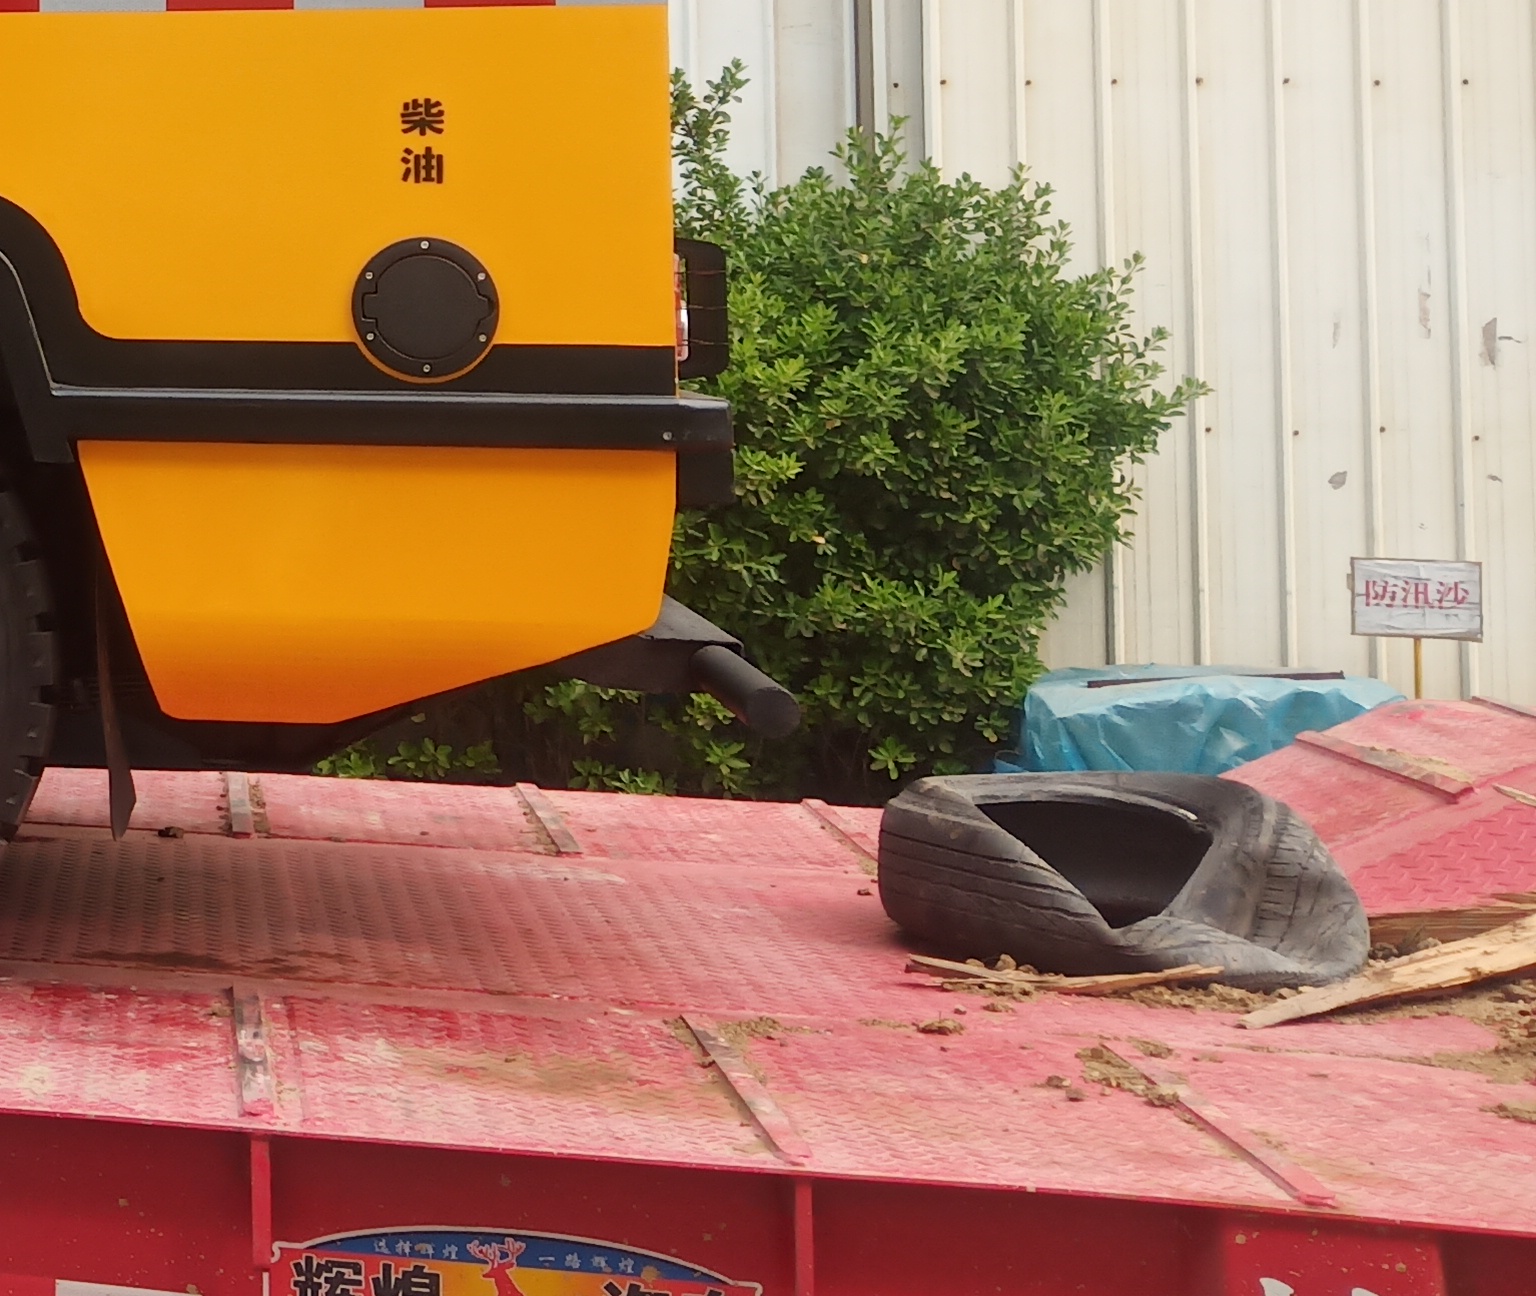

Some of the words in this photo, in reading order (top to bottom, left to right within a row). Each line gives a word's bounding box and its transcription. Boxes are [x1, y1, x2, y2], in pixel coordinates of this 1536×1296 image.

[399, 98, 445, 184] 柴油
[1365, 580, 1470, 609] 防汛沙
